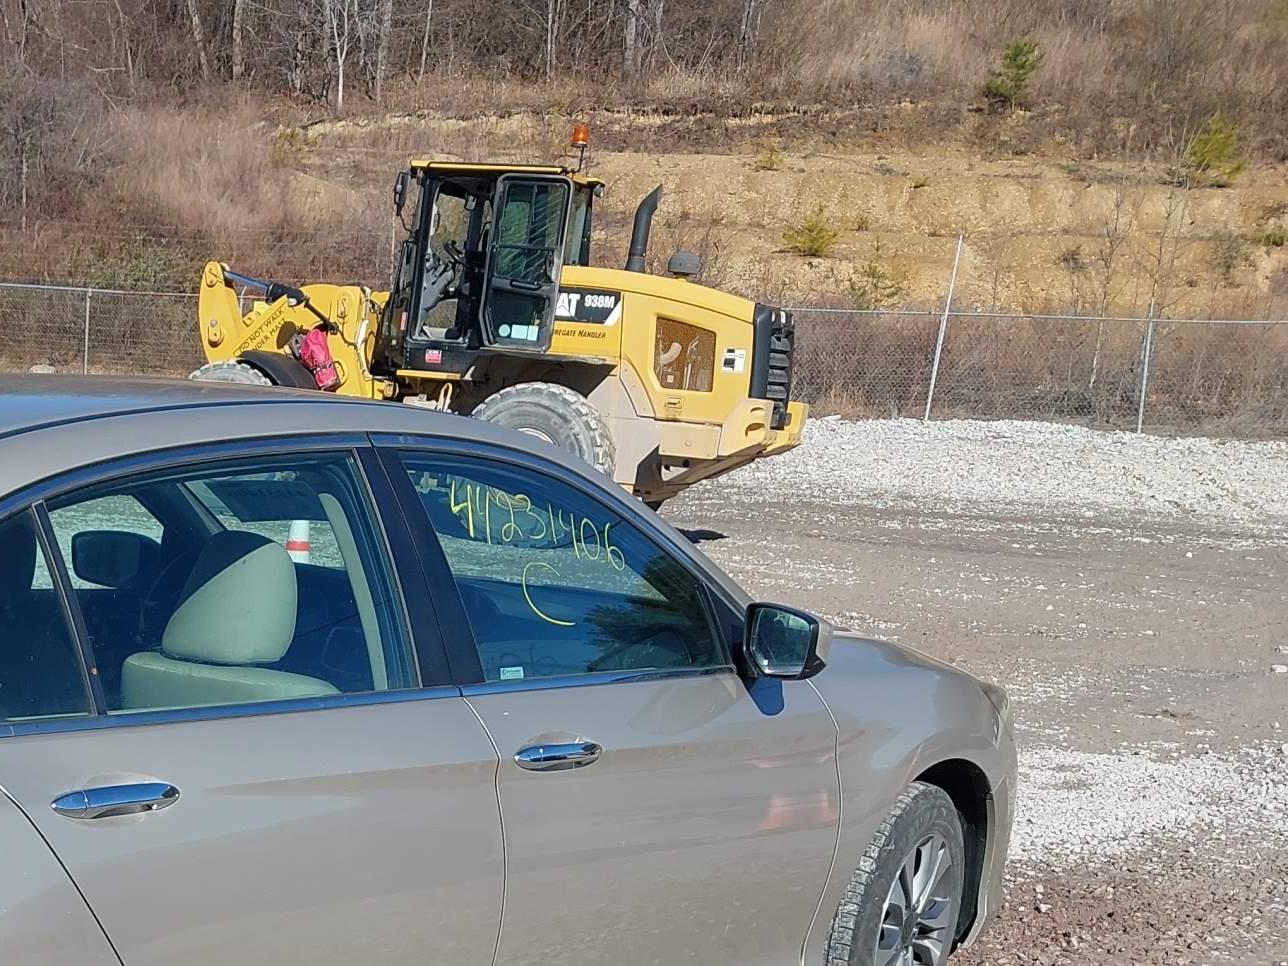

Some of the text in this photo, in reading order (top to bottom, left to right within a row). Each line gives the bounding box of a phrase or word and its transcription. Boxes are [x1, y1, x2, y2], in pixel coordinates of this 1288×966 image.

[555, 292, 615, 317] AT 938M
[249, 326, 263, 343] NOT
[264, 308, 284, 328] WALK
[450, 479, 626, 571] 44231406
